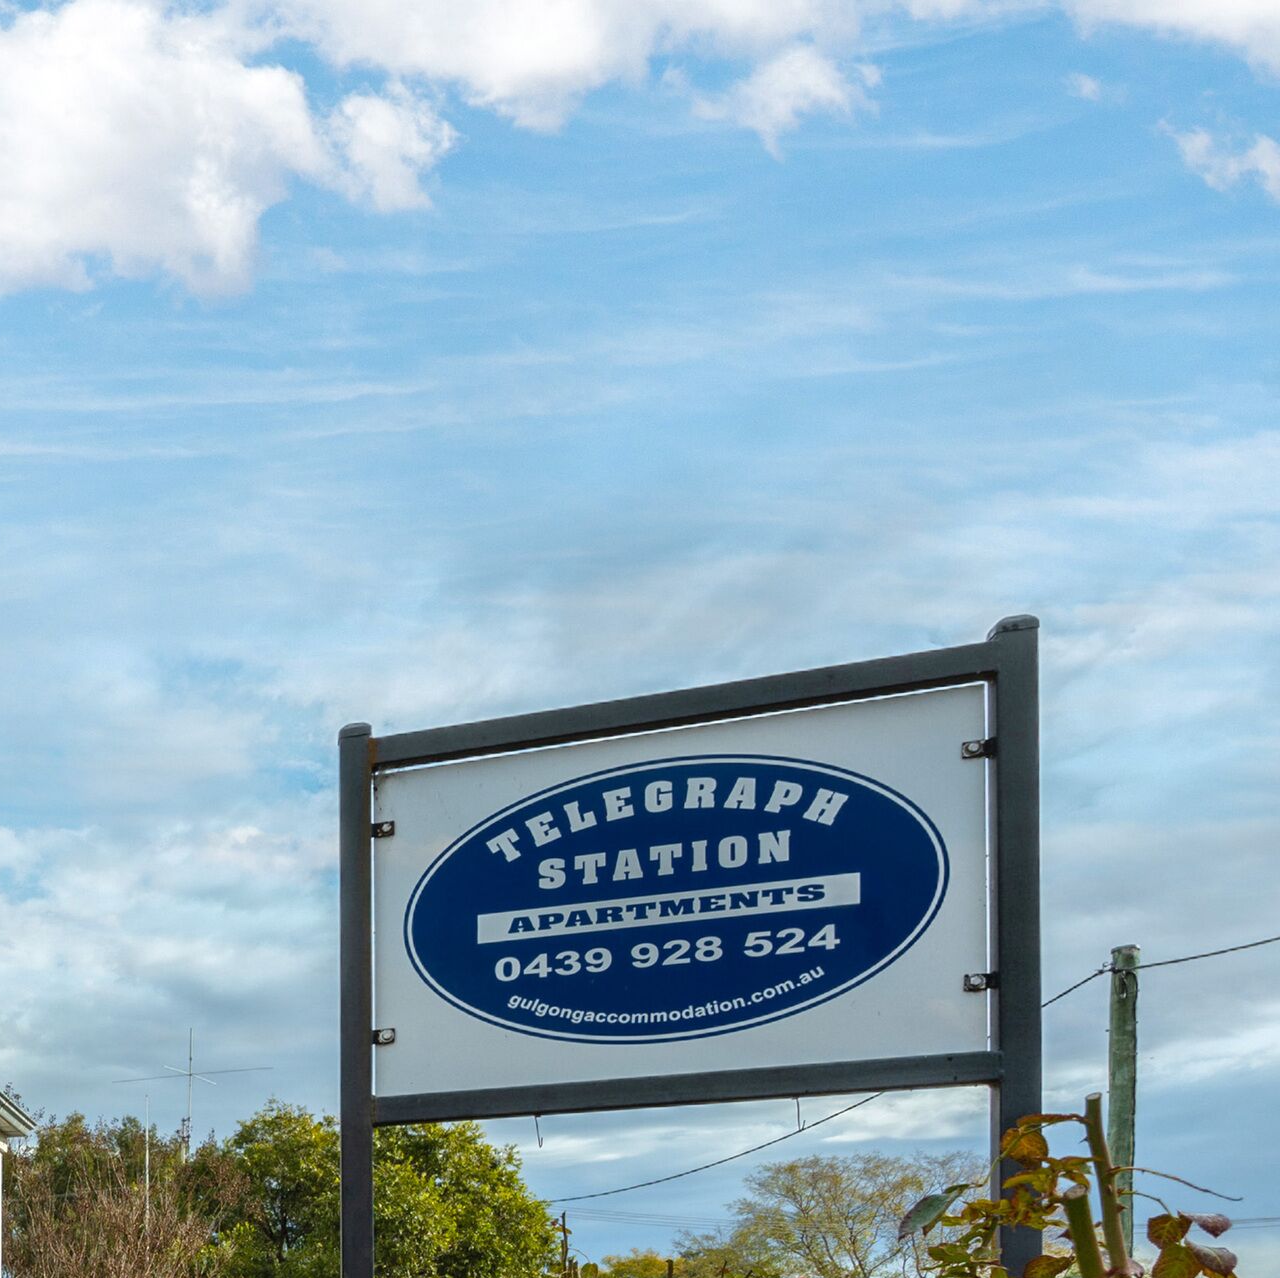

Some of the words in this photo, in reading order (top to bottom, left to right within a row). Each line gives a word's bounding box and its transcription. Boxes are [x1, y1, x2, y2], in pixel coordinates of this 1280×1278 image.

[486, 777, 849, 863] TELEGRAPH
[538, 830, 791, 889] STATION
[507, 884, 826, 934] APARTMENTS
[495, 947, 612, 982] 0439
[630, 936, 723, 969] 928
[743, 924, 841, 958] 524
[507, 964, 825, 1025] gulgongaccommodation.com.au
